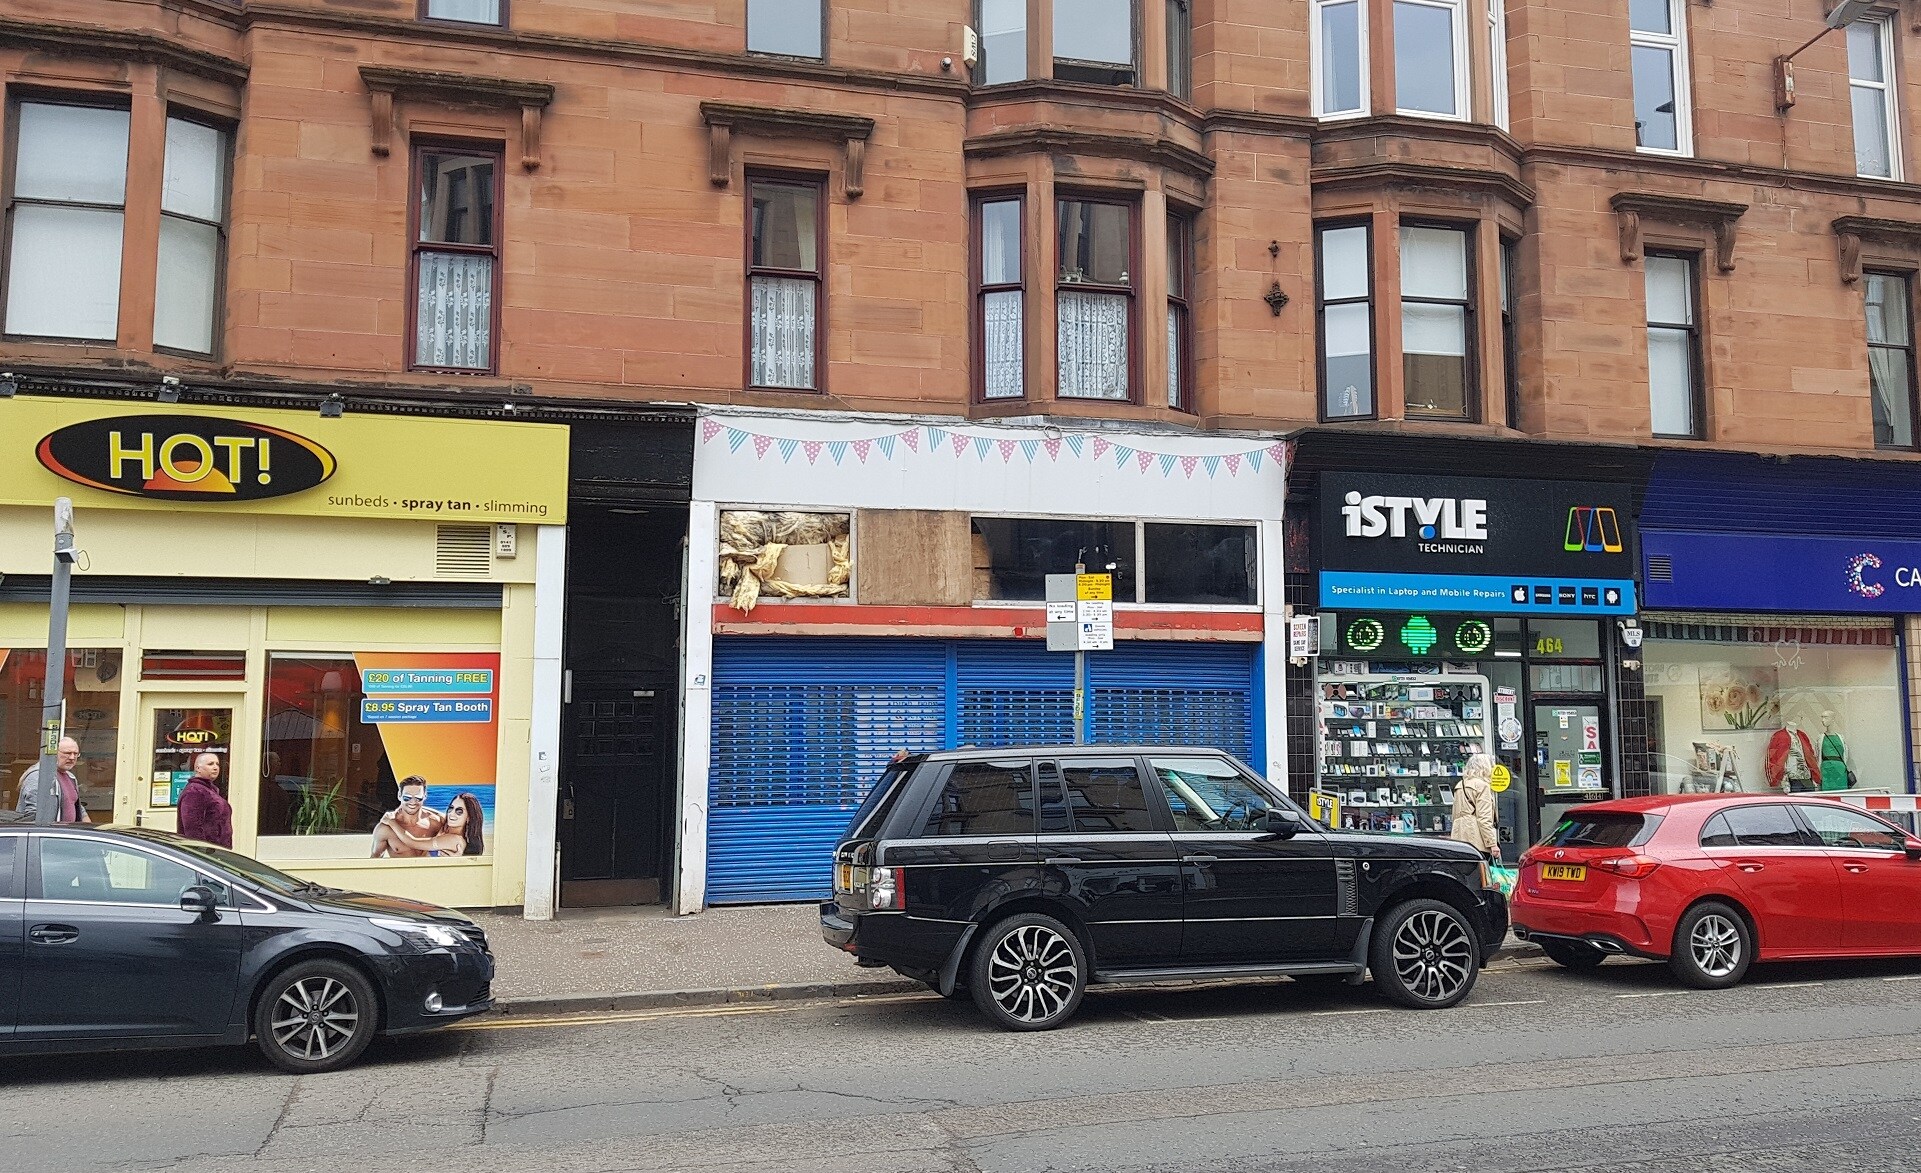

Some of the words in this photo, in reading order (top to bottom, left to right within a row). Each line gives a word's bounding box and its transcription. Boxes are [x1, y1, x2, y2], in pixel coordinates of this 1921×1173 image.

[109, 431, 271, 485] HOT!
[328, 494, 389, 508] sunbeds
[401, 499, 443, 512] spray
[447, 500, 471, 511] tan
[483, 500, 548, 517] slimming
[1342, 491, 1488, 540] iSTYLE
[1418, 543, 1484, 554] TECHNICIAN
[1331, 585, 1375, 595] Specialist
[1377, 587, 1386, 595] in
[1388, 587, 1419, 598] Laptop
[1421, 588, 1437, 596] and
[1439, 588, 1471, 597] Mobile
[1473, 589, 1506, 599] Repairs
[1536, 637, 1563, 655] 464
[368, 673, 390, 683] £20
[392, 673, 405, 683] of
[407, 673, 453, 685] Tanning
[456, 673, 489, 683] FREE
[365, 702, 395, 713] £8.95
[397, 702, 430, 714] Spray
[433, 702, 452, 712] Tan
[455, 702, 489, 713] Booth
[176, 731, 209, 742] HOT!
[1547, 866, 1565, 878] KW19
[1566, 867, 1581, 879] TWD
